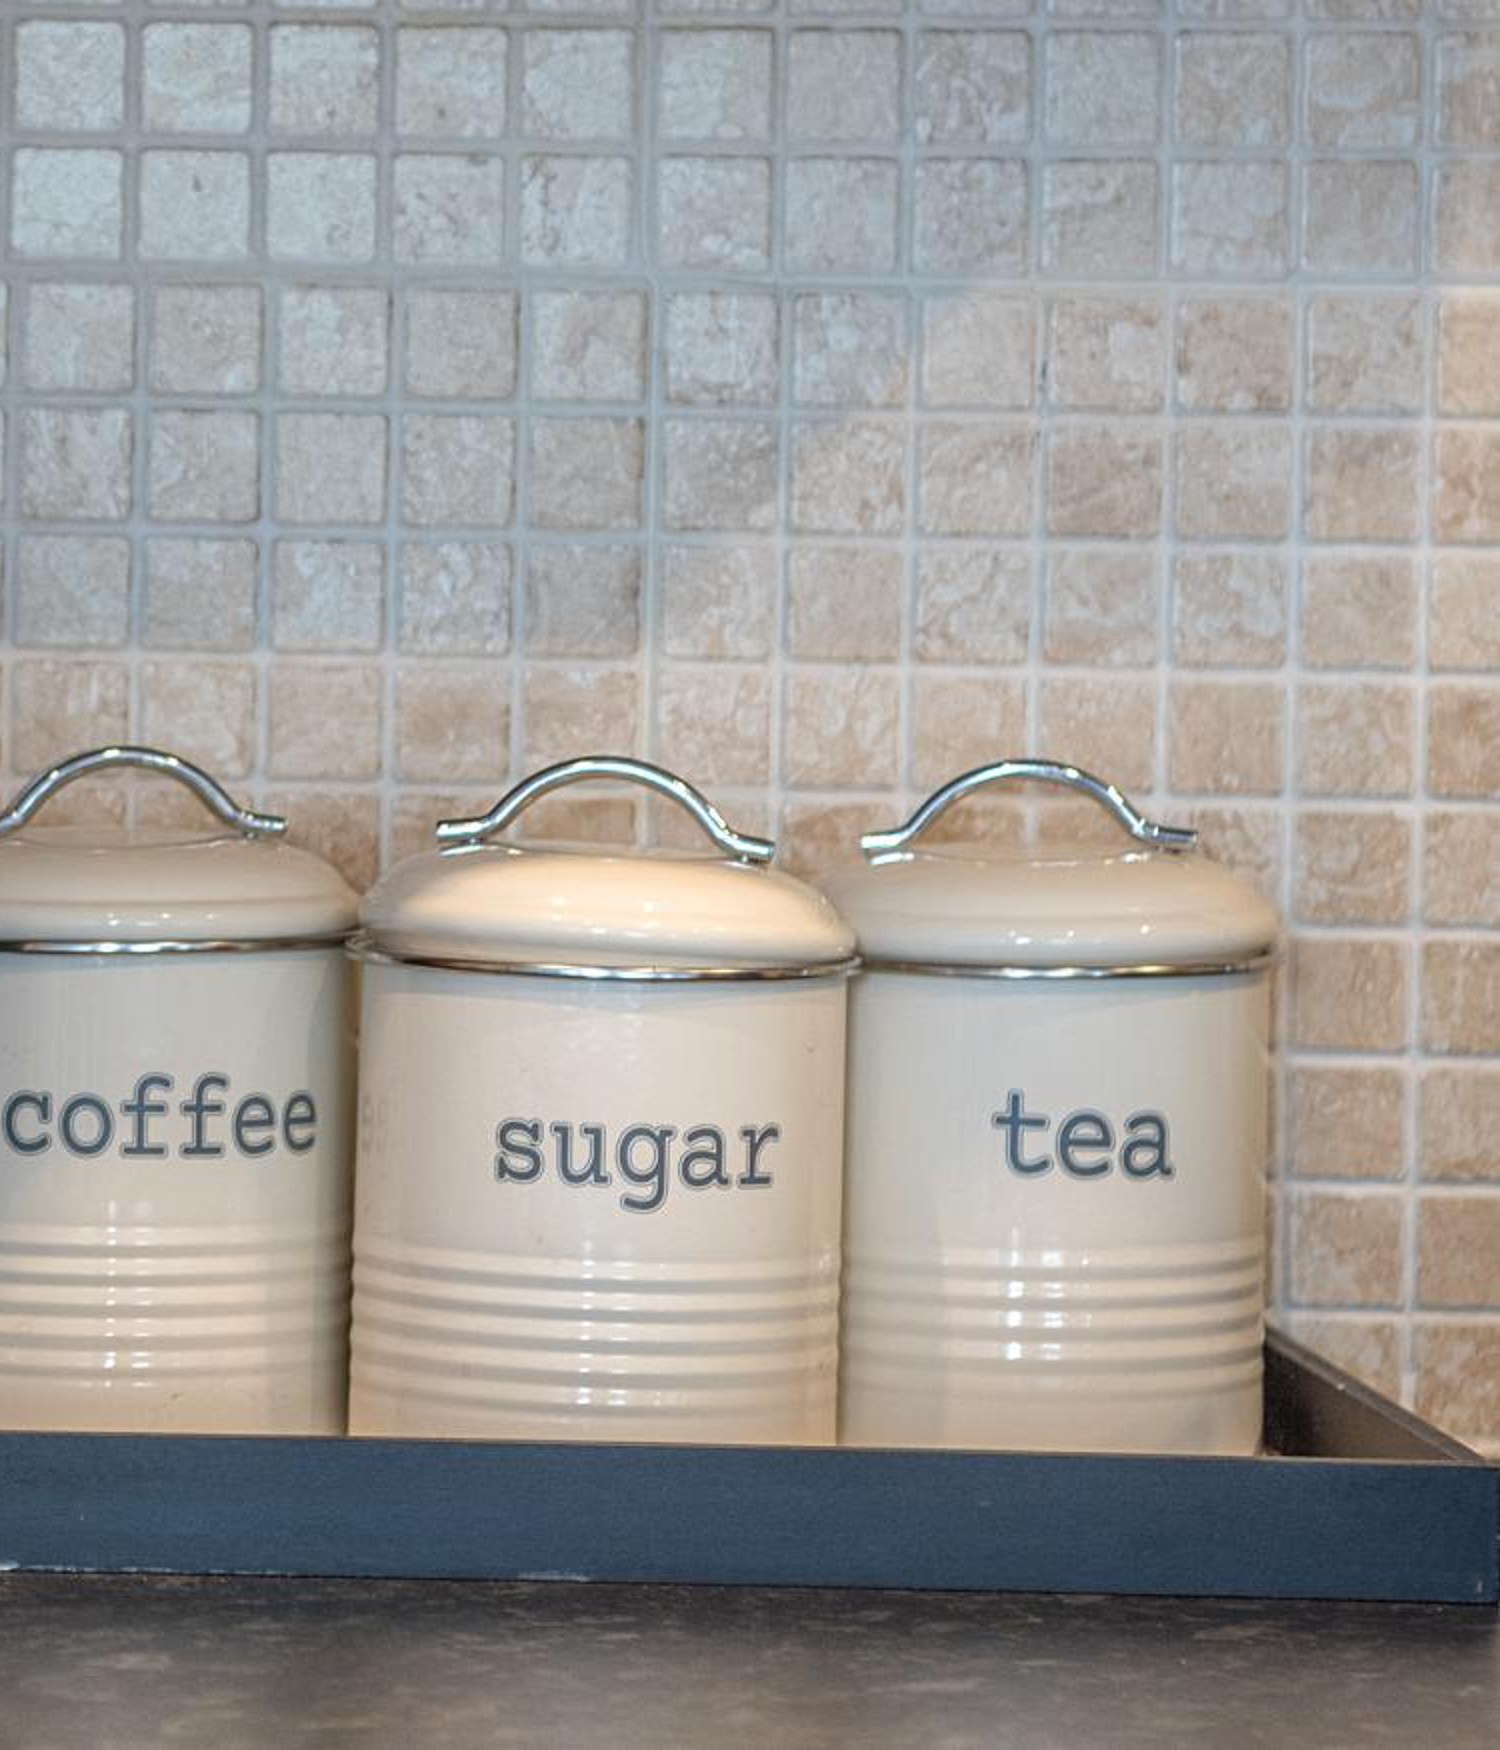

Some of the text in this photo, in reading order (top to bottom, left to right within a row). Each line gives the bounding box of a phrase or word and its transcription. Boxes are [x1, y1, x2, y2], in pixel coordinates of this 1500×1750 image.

[2, 1074, 318, 1156] coffee
[994, 1092, 1173, 1178] tea
[496, 1120, 779, 1211] sugar
